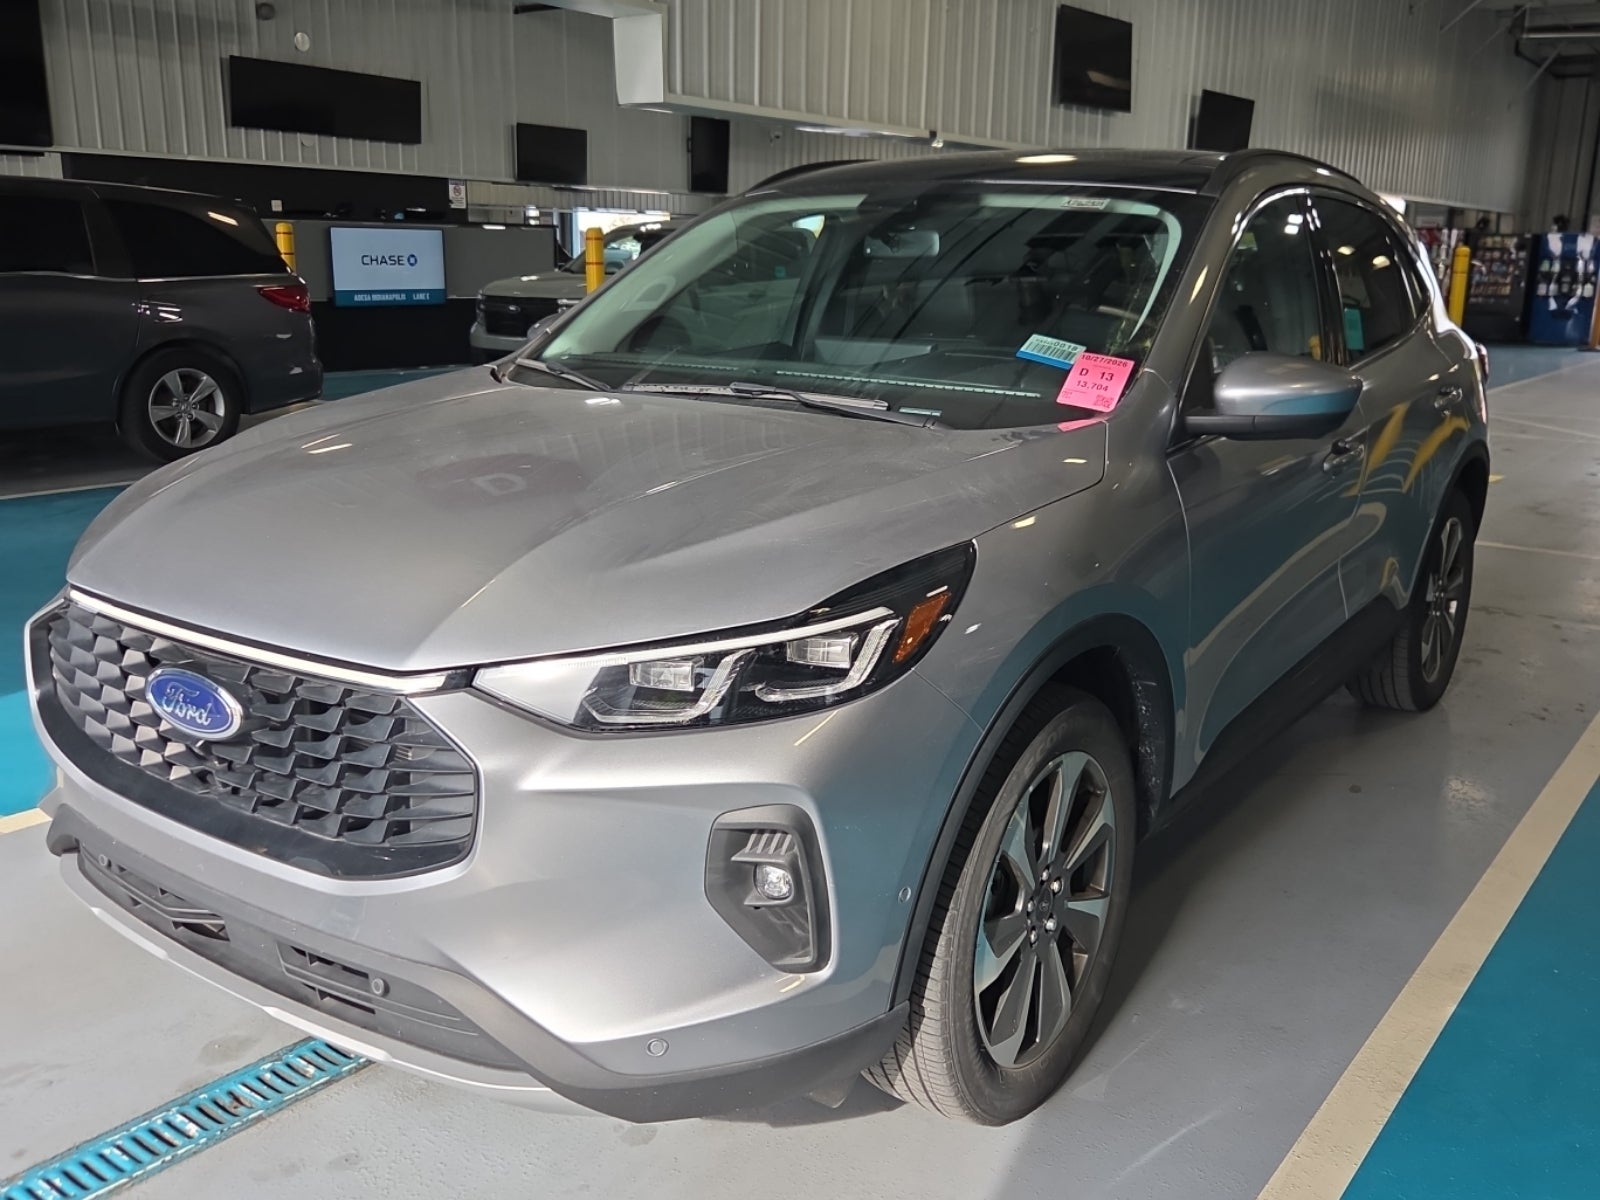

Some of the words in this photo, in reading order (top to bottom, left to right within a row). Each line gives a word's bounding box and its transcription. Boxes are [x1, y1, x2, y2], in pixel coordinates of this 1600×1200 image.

[361, 255, 405, 266] CHASE
[1100, 371, 1114, 382] 13
[162, 681, 212, 726] Ford
